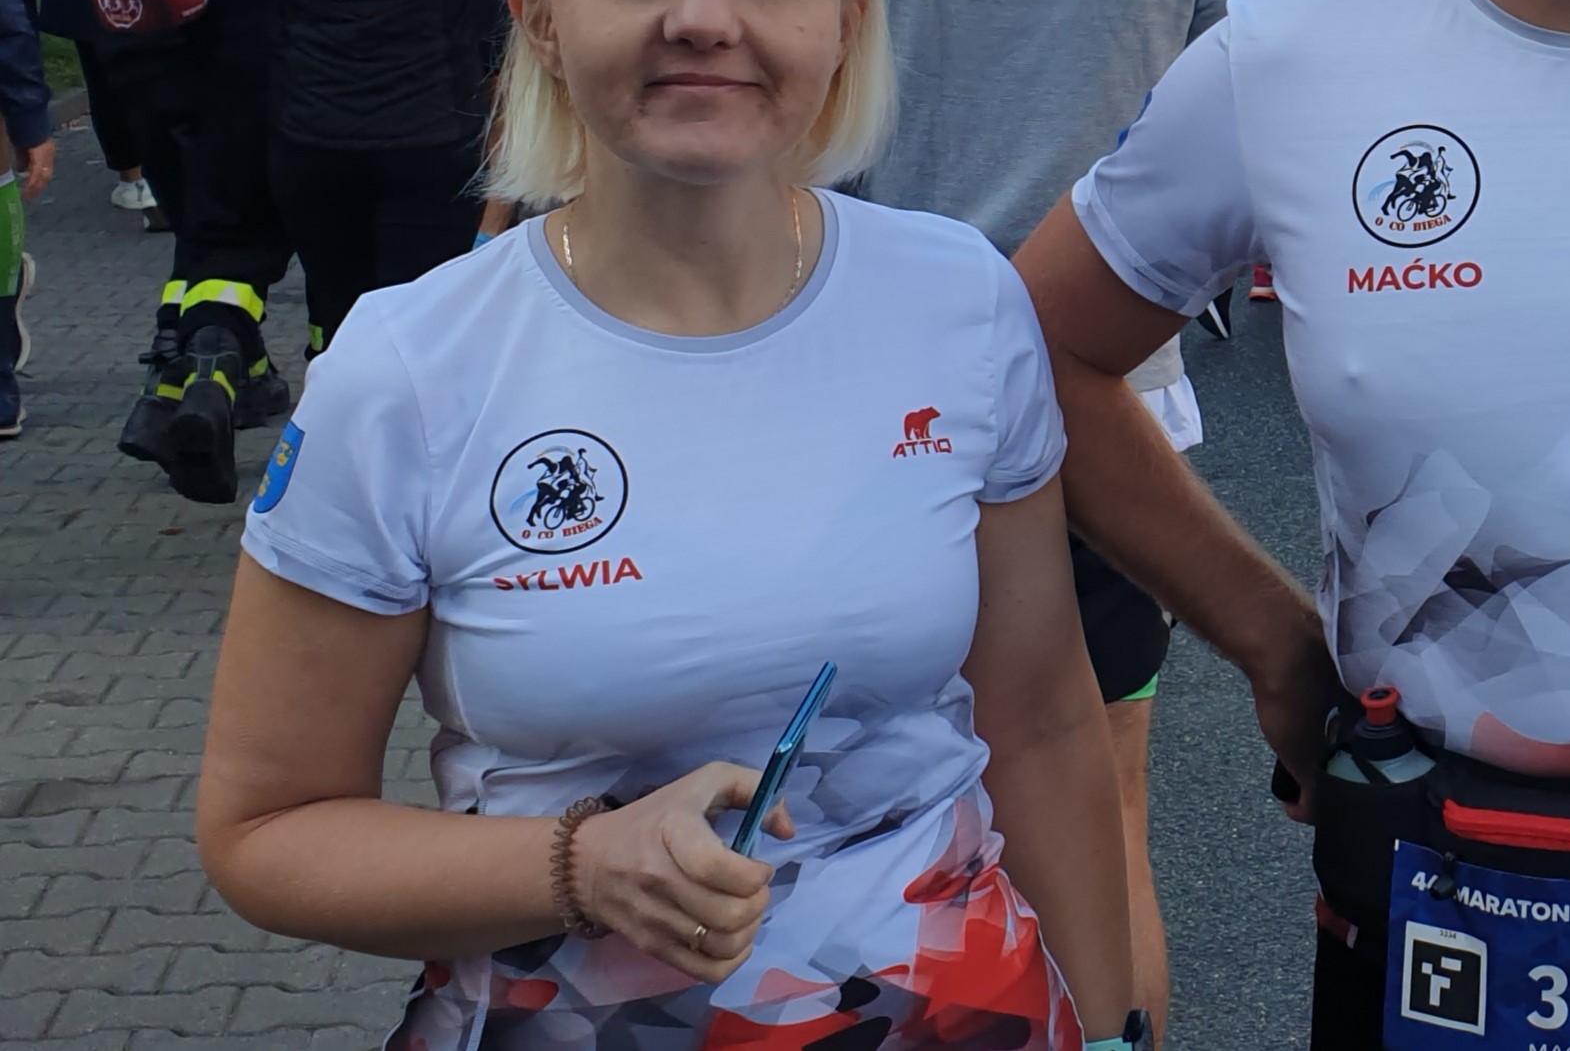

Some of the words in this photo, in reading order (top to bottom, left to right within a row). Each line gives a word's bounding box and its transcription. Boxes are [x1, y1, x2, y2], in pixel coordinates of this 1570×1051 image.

[1413, 214, 1452, 232] BIEGA
[1348, 258, 1483, 293] MAĆKO
[893, 438, 952, 458] ATTIQ
[562, 516, 603, 537] BIEGA
[1453, 886, 1570, 923] MARATON
